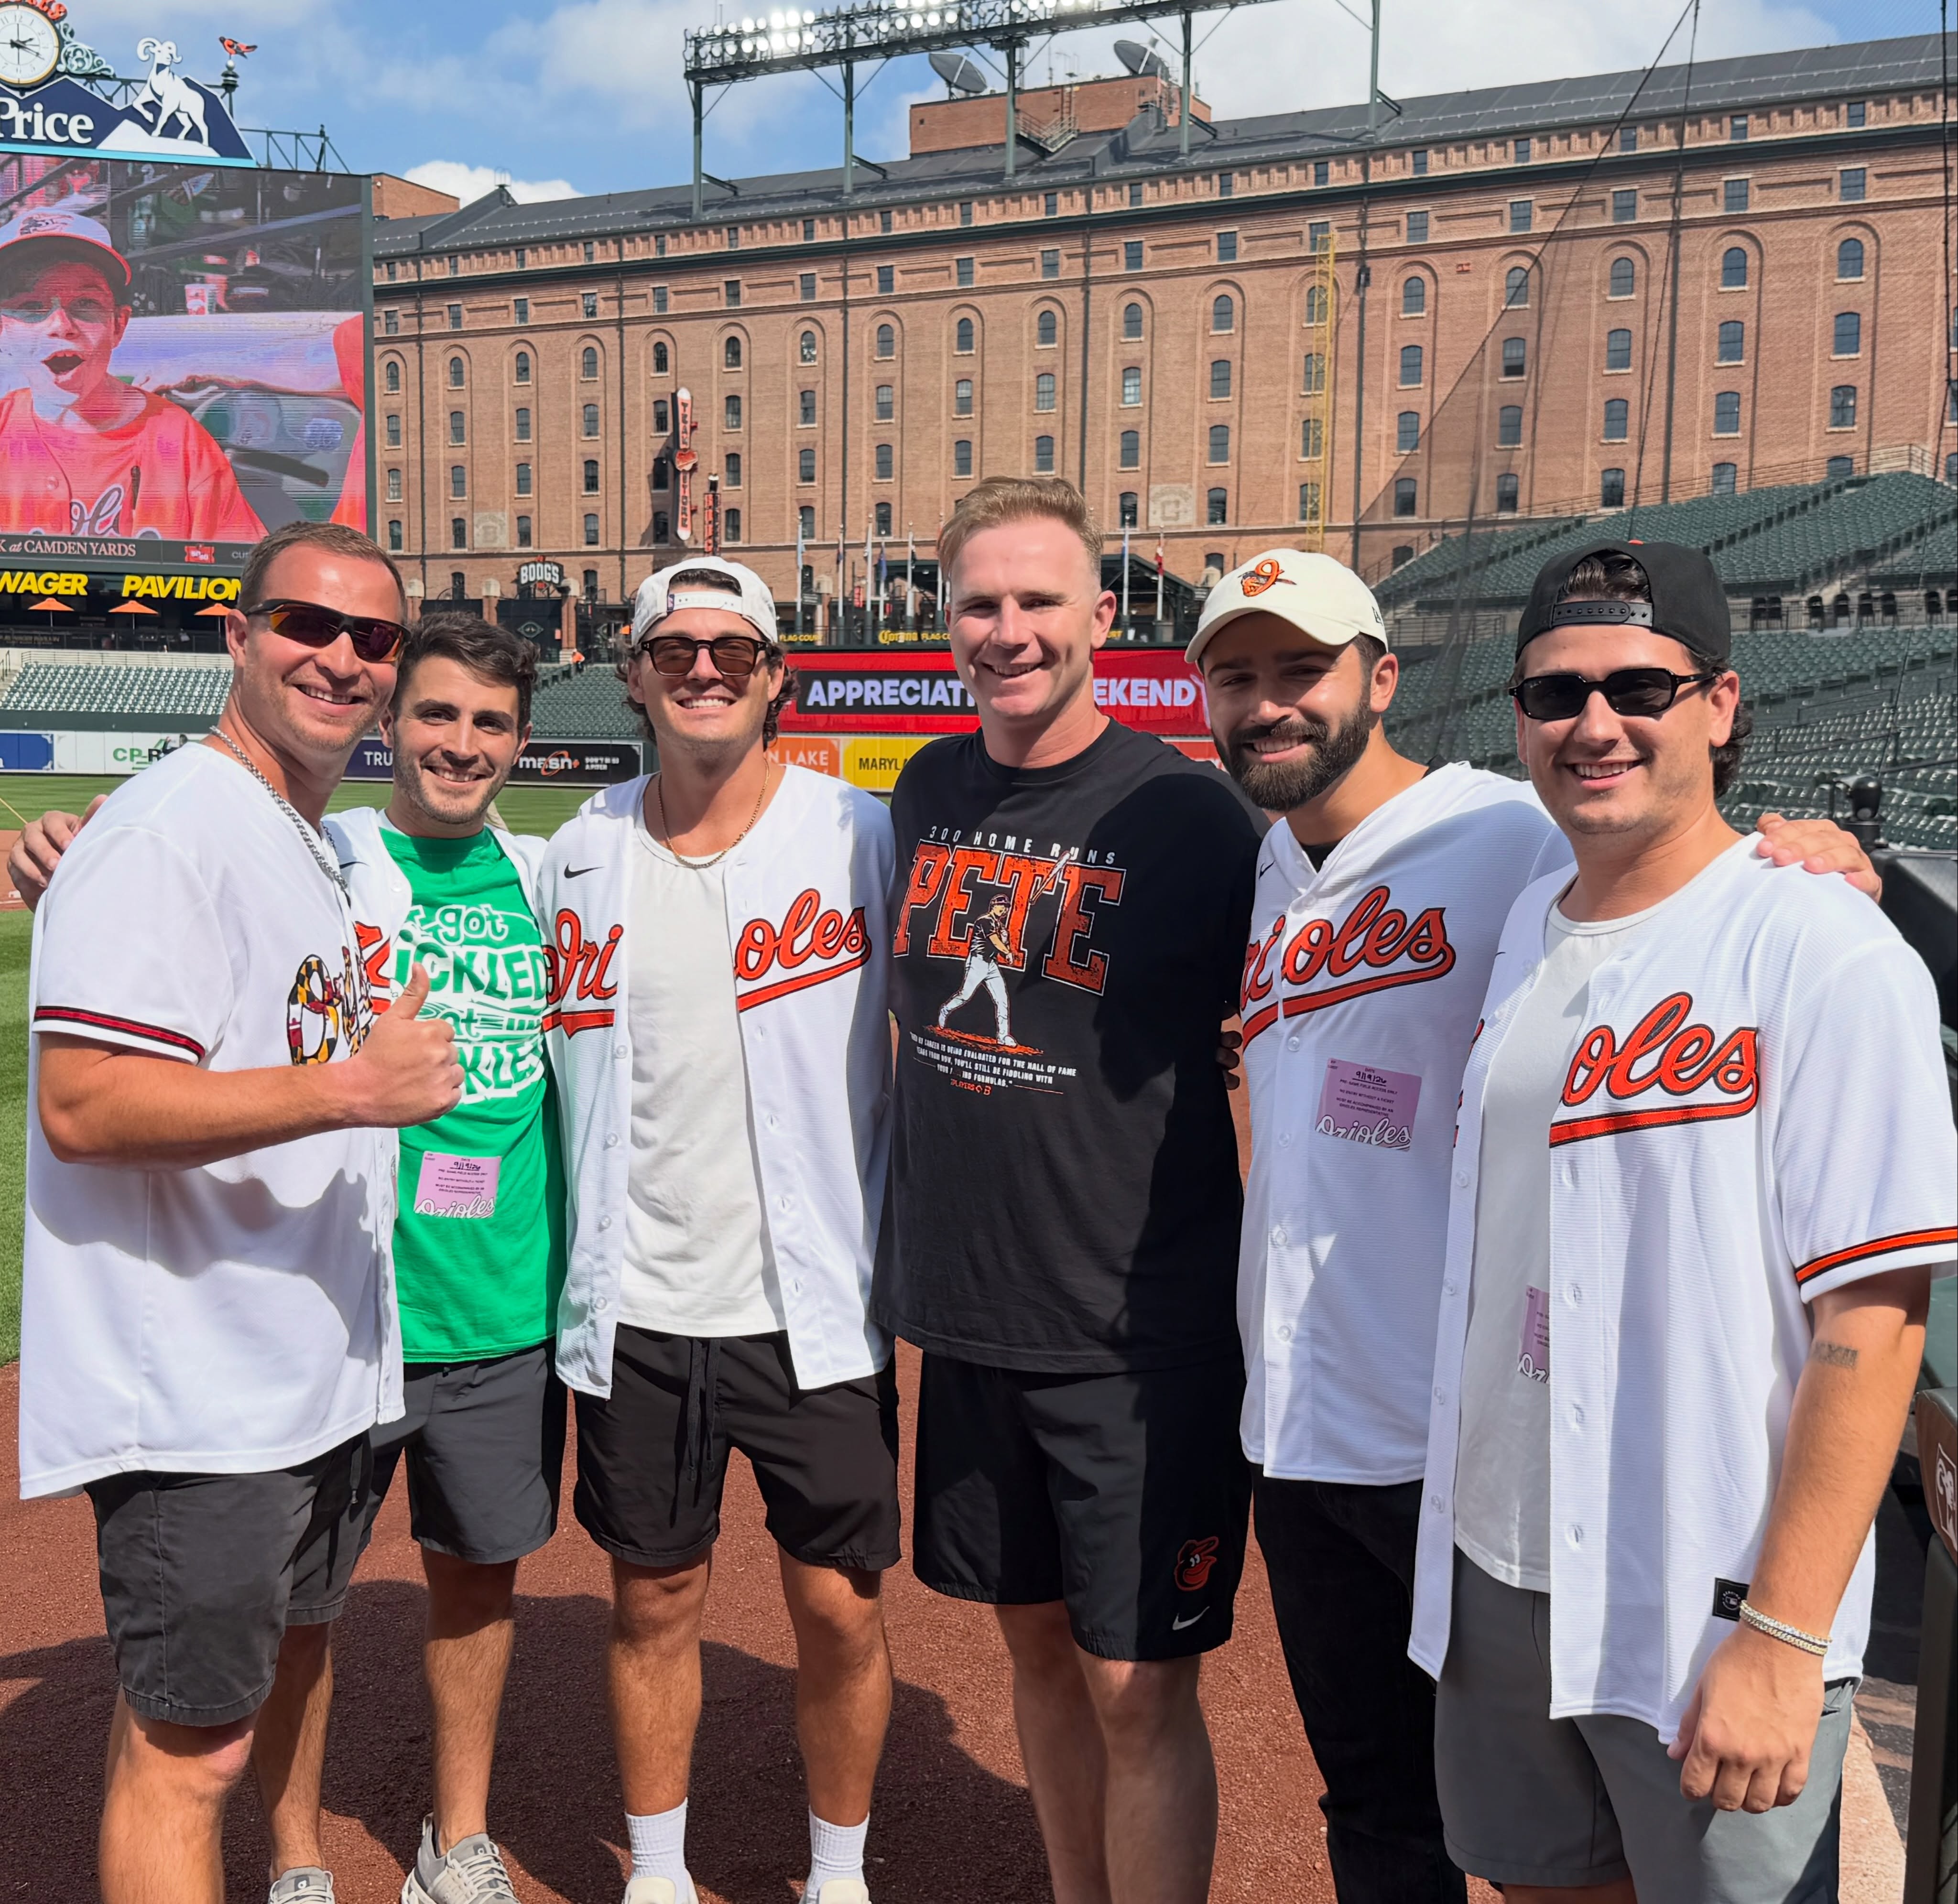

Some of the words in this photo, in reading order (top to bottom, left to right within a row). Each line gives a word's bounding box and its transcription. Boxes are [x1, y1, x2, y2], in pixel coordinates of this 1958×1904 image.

[9, 543, 22, 553] at
[24, 540, 87, 555] CAMDEN
[90, 542, 137, 557] YARDS
[1093, 679, 1196, 707] EKEND
[786, 750, 829, 766] LAKE
[929, 826, 961, 843] 300
[973, 831, 1033, 853] HOME
[1050, 843, 1115, 865] RUNS
[435, 904, 509, 945] got
[893, 839, 1127, 996] PETE
[395, 941, 546, 1001] ICKLED
[964, 1049, 997, 1063] EVALUATED
[998, 1057, 1011, 1066] FOR
[1013, 1059, 1025, 1069] THE
[1027, 1061, 1044, 1072] HALL
[1047, 1065, 1056, 1074] OF
[1057, 1067, 1077, 1077] FAME
[1559, 991, 1760, 1107] oles
[974, 1062, 990, 1073] STILL
[992, 1066, 1001, 1075] BE
[1002, 1068, 1033, 1081] FIDDLING
[1035, 1074, 1053, 1084] WITH
[1315, 1114, 1412, 1147] Orioles
[414, 1194, 495, 1219] Orioles
